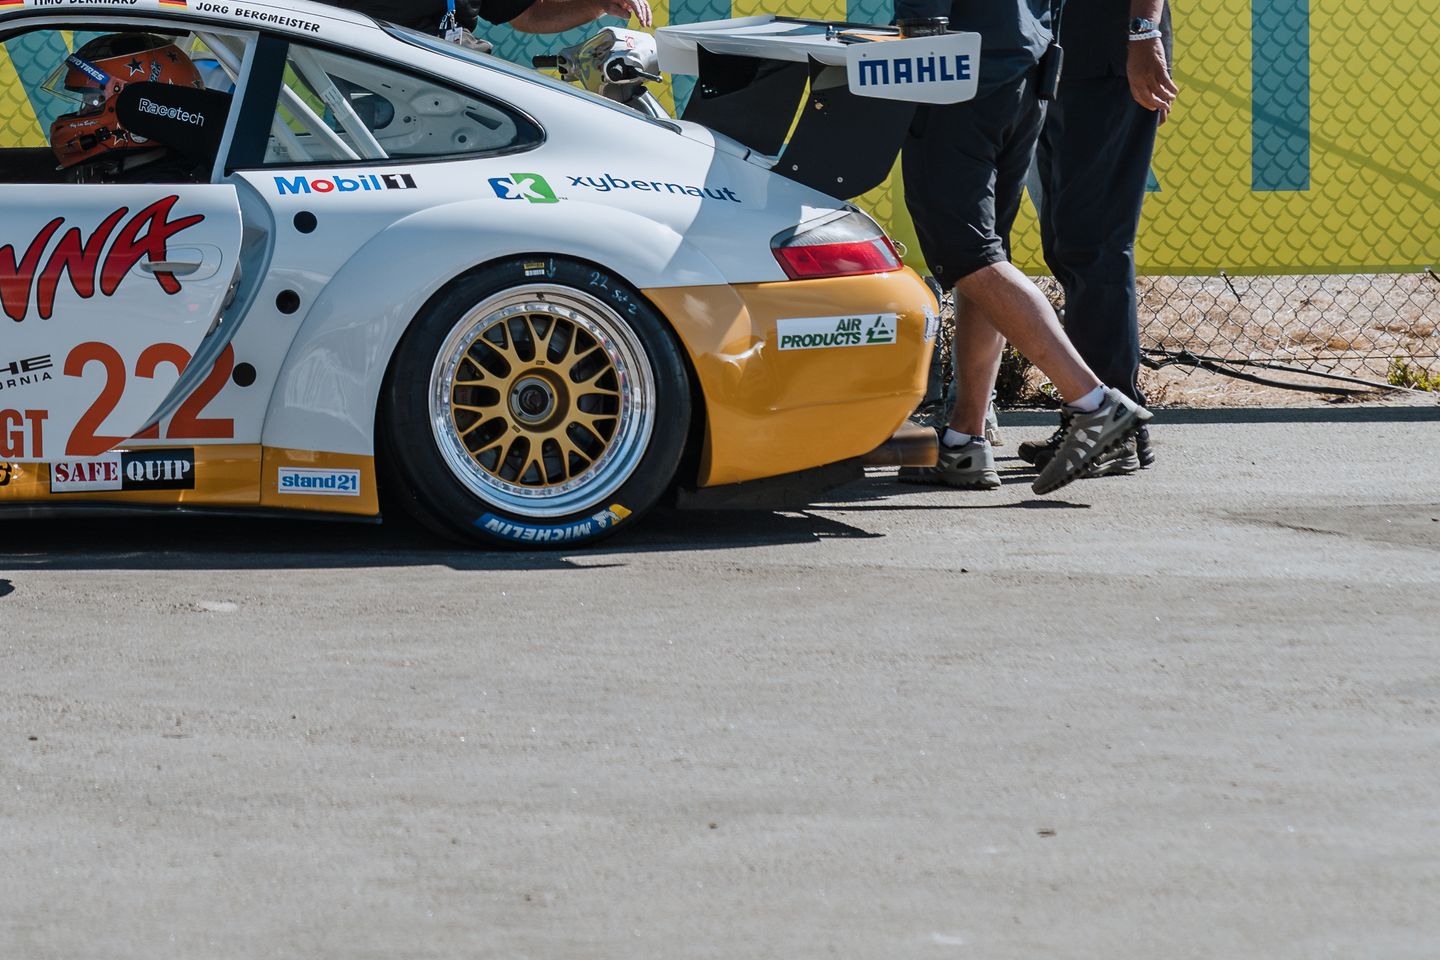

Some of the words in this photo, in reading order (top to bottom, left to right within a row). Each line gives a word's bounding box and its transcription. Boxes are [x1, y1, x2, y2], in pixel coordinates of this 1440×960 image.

[196, 1, 230, 15] JORG
[235, 5, 321, 33] BERGMEISTER
[80, 62, 105, 81] TIRES
[858, 54, 971, 86] MAHLE
[138, 97, 205, 127] Racetech
[566, 173, 742, 203] xybernaut
[589, 271, 609, 289] 22
[836, 318, 862, 332] AIR
[780, 331, 862, 348] PRODUCTS
[63, 341, 235, 456] 22
[55, 461, 118, 483] SAFE
[126, 459, 191, 482] QUIP
[281, 473, 357, 491] stand21
[485, 518, 592, 541] MICHELIN
